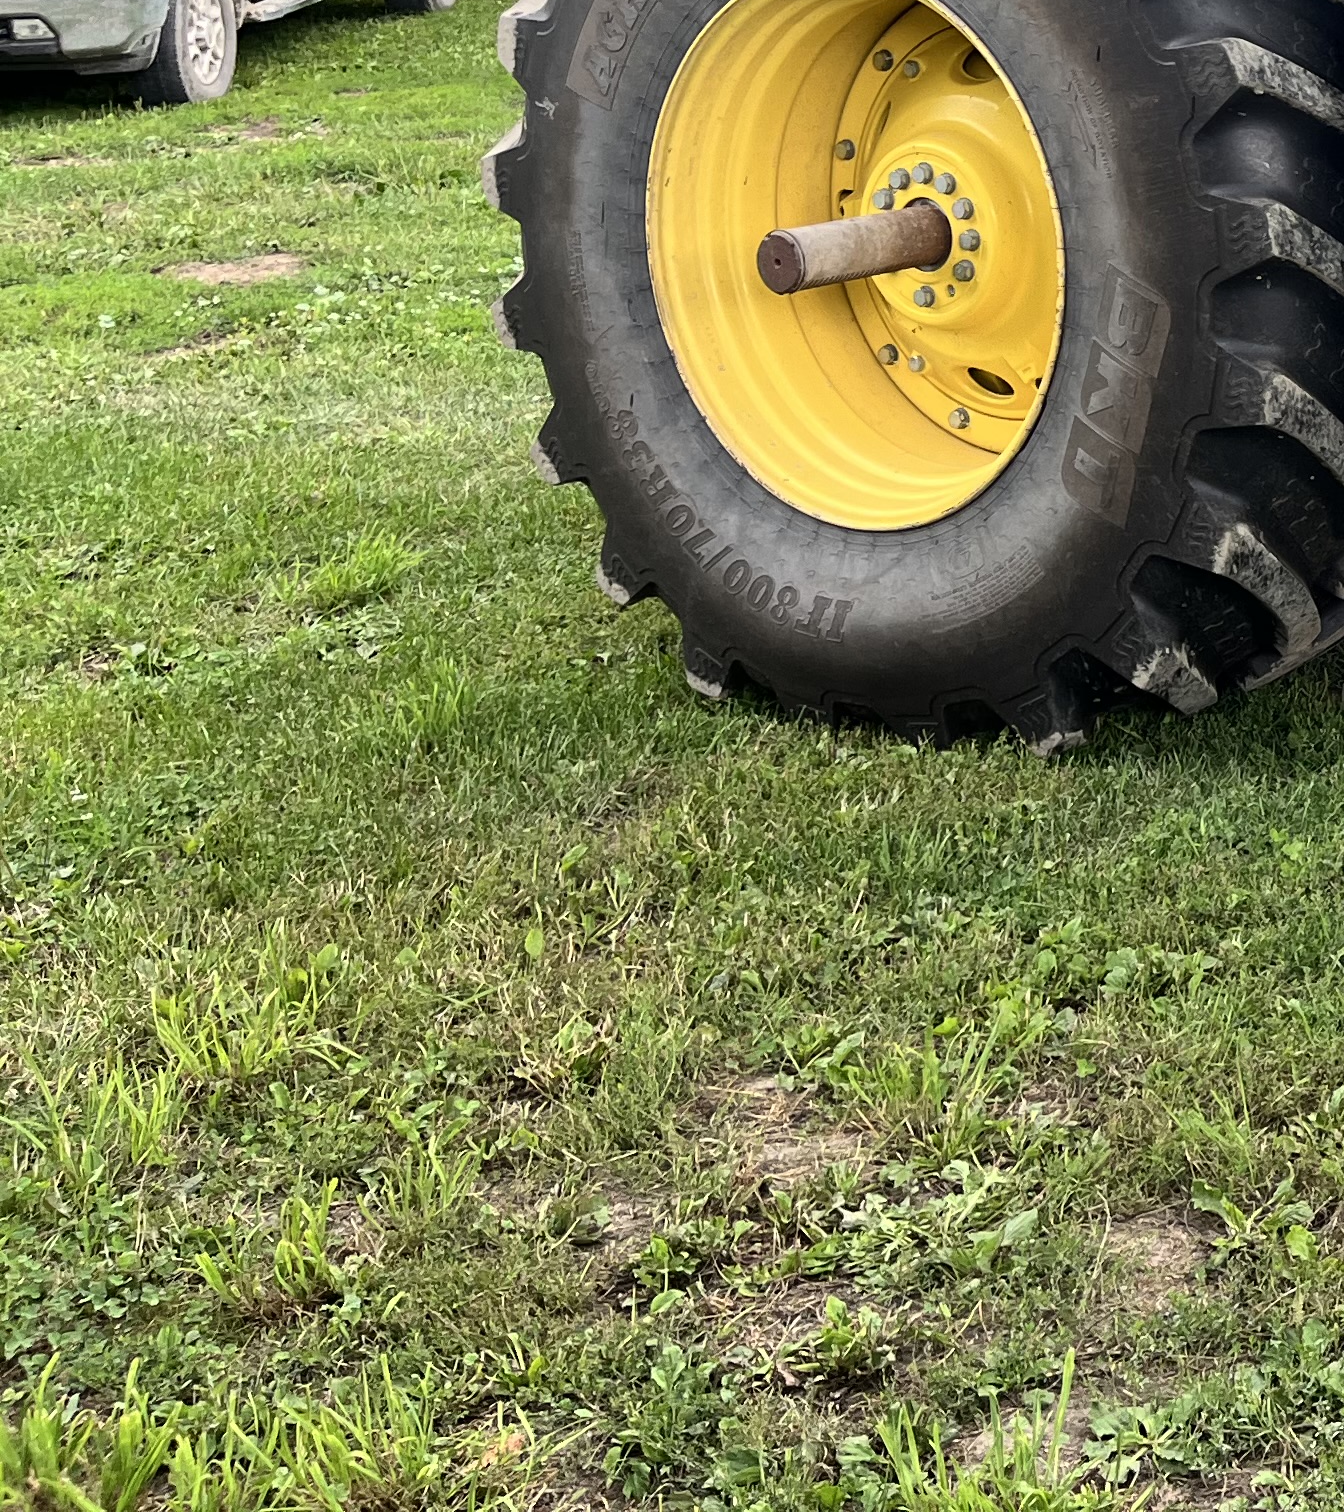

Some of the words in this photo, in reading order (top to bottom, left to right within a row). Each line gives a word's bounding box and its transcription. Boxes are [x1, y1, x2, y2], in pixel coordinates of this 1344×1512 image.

[1073, 275, 1160, 510] BKT
[605, 408, 799, 626] 800/70R38
[793, 592, 855, 643] IF
